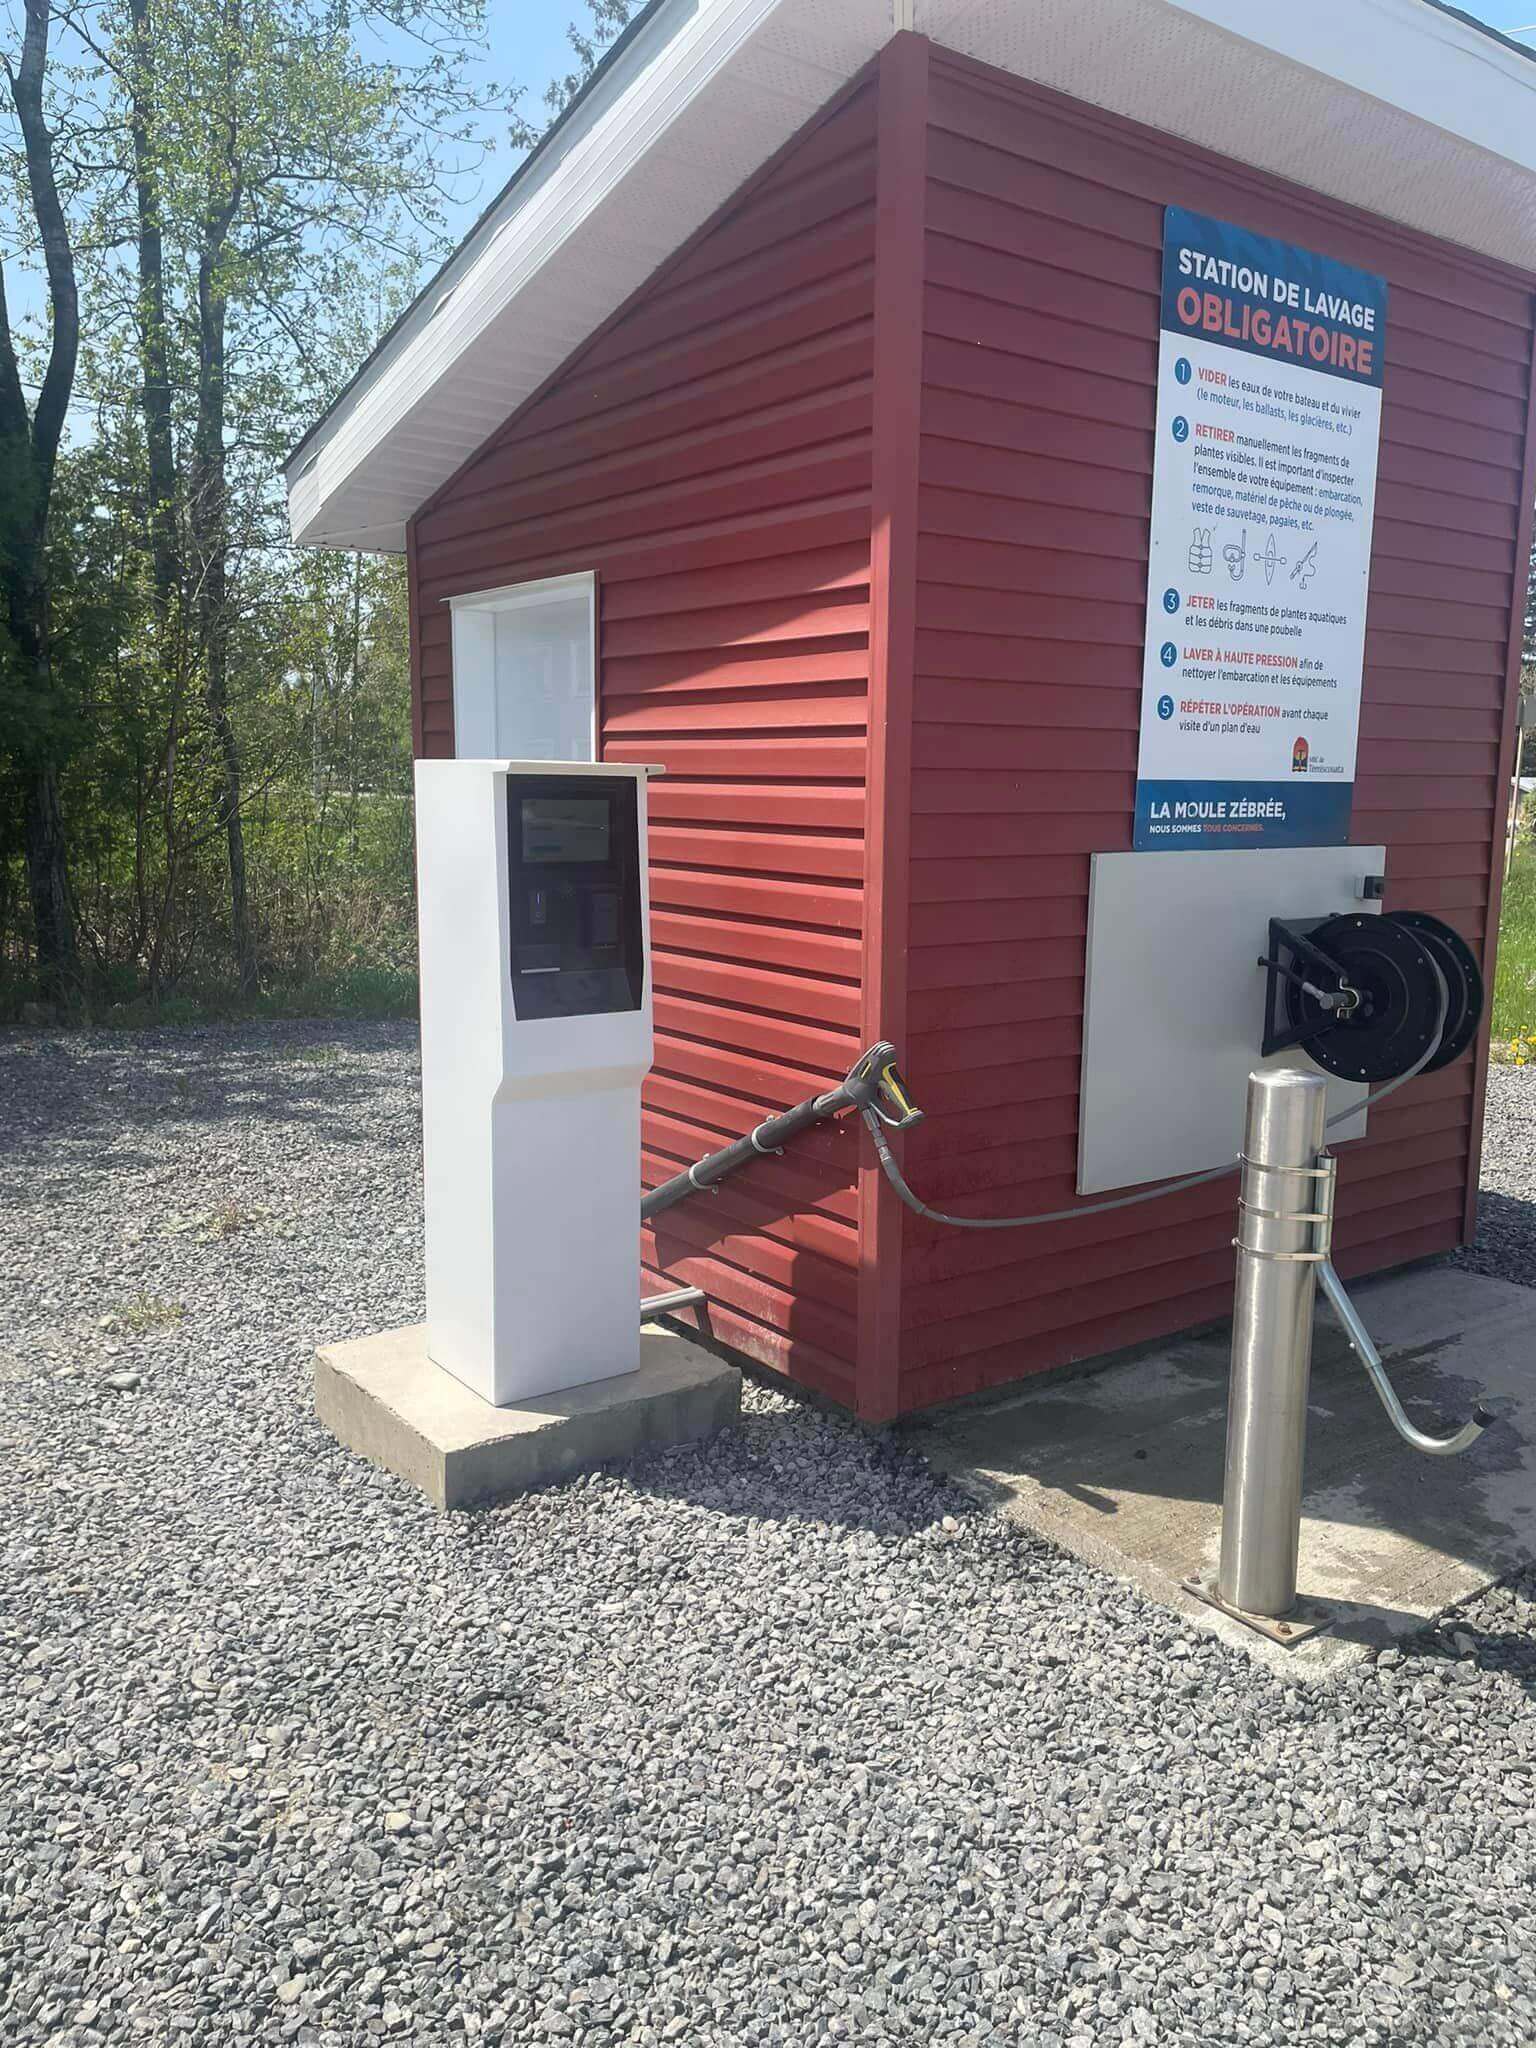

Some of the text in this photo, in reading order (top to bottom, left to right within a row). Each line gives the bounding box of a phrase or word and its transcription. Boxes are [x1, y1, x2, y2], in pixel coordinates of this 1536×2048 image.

[1178, 248, 1375, 331] STATION DE LAVAGE
[1177, 287, 1374, 376] OBLIGATOIRE
[1197, 387, 1208, 401] (le
[1210, 392, 1241, 410] moteur,
[1243, 398, 1254, 411] les
[1255, 401, 1287, 421] ballasts,
[1288, 409, 1299, 422] les
[1198, 367, 1227, 386] VIDER
[1228, 376, 1240, 389] les
[1241, 381, 1260, 395] eaux
[1262, 385, 1272, 398] de
[1274, 389, 1294, 402] votre
[1295, 392, 1320, 409] bateau
[1321, 400, 1329, 411] et
[1330, 402, 1340, 414] du
[1341, 405, 1361, 419] vivier
[1195, 423, 1235, 443] RETIRER
[1236, 435, 1290, 455] manuellement
[1292, 445, 1302, 458] les
[1303, 447, 1340, 465] fragments
[1340, 456, 1350, 468] de
[1194, 444, 1354, 486] plantes visibles. Il est important d'inspecter
[1193, 461, 1236, 480] l'ensemble
[1237, 471, 1248, 483] de
[1249, 474, 1269, 487] votre
[1270, 476, 1314, 496] équipement
[1318, 487, 1363, 507] embarcation,
[1191, 501, 1315, 531] veste de sauvetage, pagaies, etc.
[1192, 483, 1354, 522] remorque, matériel de pêche ou de plongée,
[1186, 595, 1215, 610] JETER
[1216, 600, 1228, 611] les
[1229, 599, 1268, 616] fragments
[1269, 605, 1279, 617] de
[1280, 607, 1308, 621] plantes
[1308, 611, 1347, 624] aquatiques
[1185, 615, 1303, 637] et les débris dans une poubelle
[1183, 647, 1213, 662] LAVER
[1214, 647, 1222, 662] À
[1224, 651, 1254, 664] HAUTE
[1256, 653, 1298, 668] PRESSION
[1299, 658, 1313, 669] afin
[1314, 659, 1323, 670] de
[1182, 667, 1337, 688] nettoyer l'embarcation et les équipements
[1180, 698, 1221, 714] RÉPÉTER
[1223, 701, 1280, 718] L'OPÉRATION
[1281, 708, 1302, 719] avant
[1303, 708, 1329, 721] chaque
[1179, 719, 1261, 734] visite d'un plan d'eau
[1150, 797, 1286, 820] LA MOULE ZÉBRÉE,
[1150, 824, 1171, 834] NOUS
[1172, 824, 1202, 833] SOMMES
